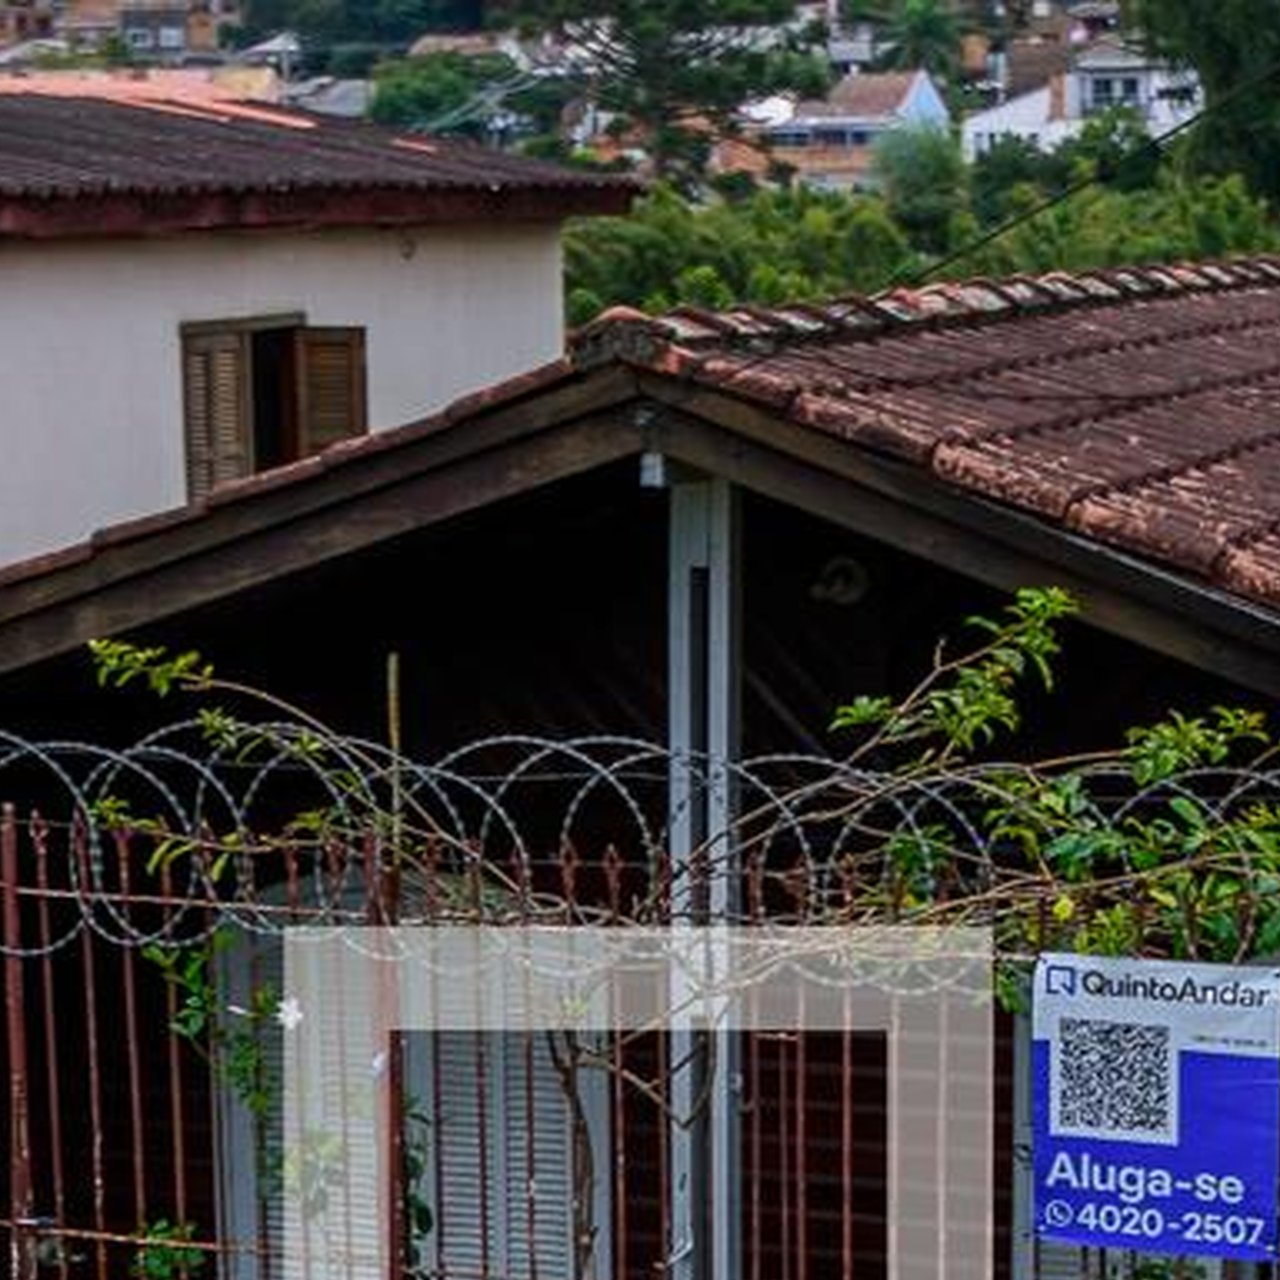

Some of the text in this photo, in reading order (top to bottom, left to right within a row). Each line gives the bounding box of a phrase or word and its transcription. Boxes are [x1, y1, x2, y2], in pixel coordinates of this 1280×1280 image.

[1082, 970, 1271, 1008] QuintoAndar
[1046, 1152, 1245, 1204] Aluga-se
[1076, 1204, 1265, 1245] 4020-2507
